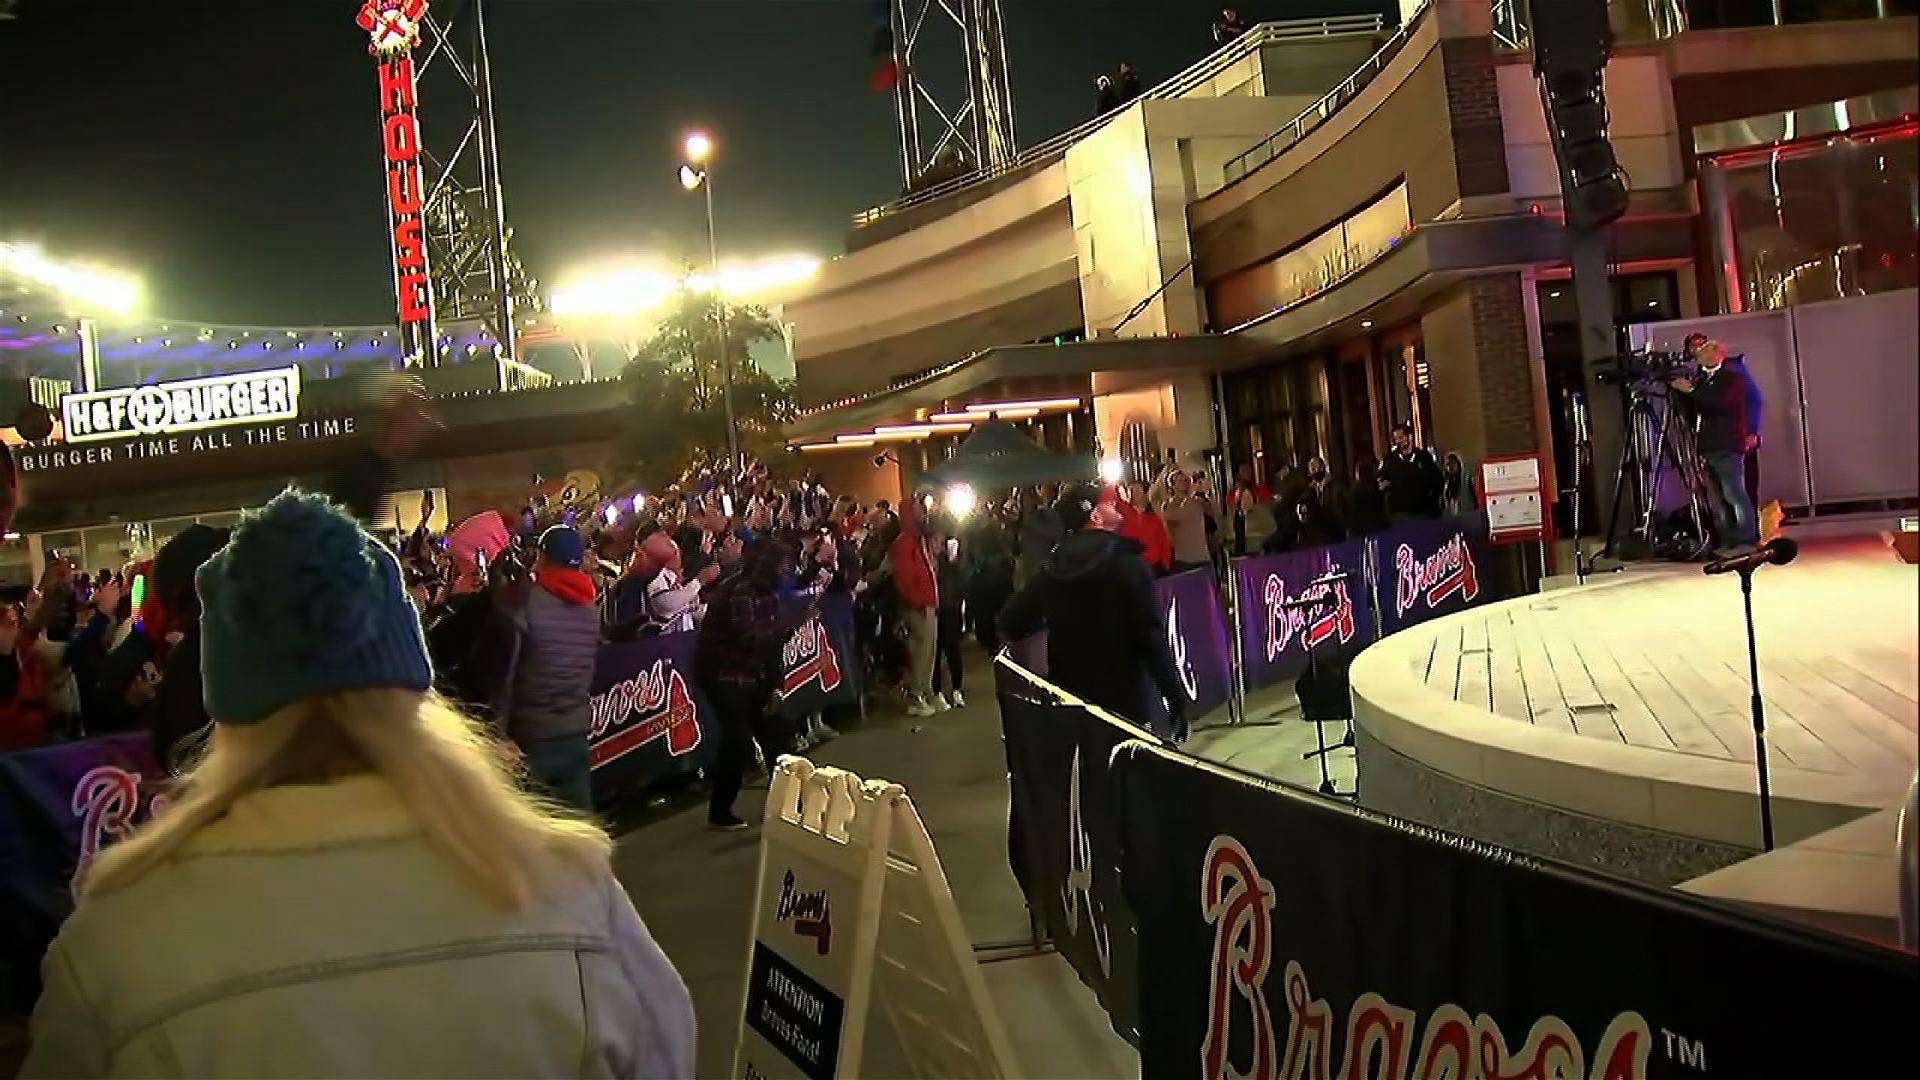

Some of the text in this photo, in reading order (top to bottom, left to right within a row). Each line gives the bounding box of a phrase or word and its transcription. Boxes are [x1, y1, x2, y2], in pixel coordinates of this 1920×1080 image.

[378, 58, 428, 321] HOUSE
[71, 397, 127, 435] H&F
[172, 377, 288, 423] BURGER
[22, 417, 356, 471] BURGER TIME ALL THE TIME
[1396, 533, 1461, 618] Braves
